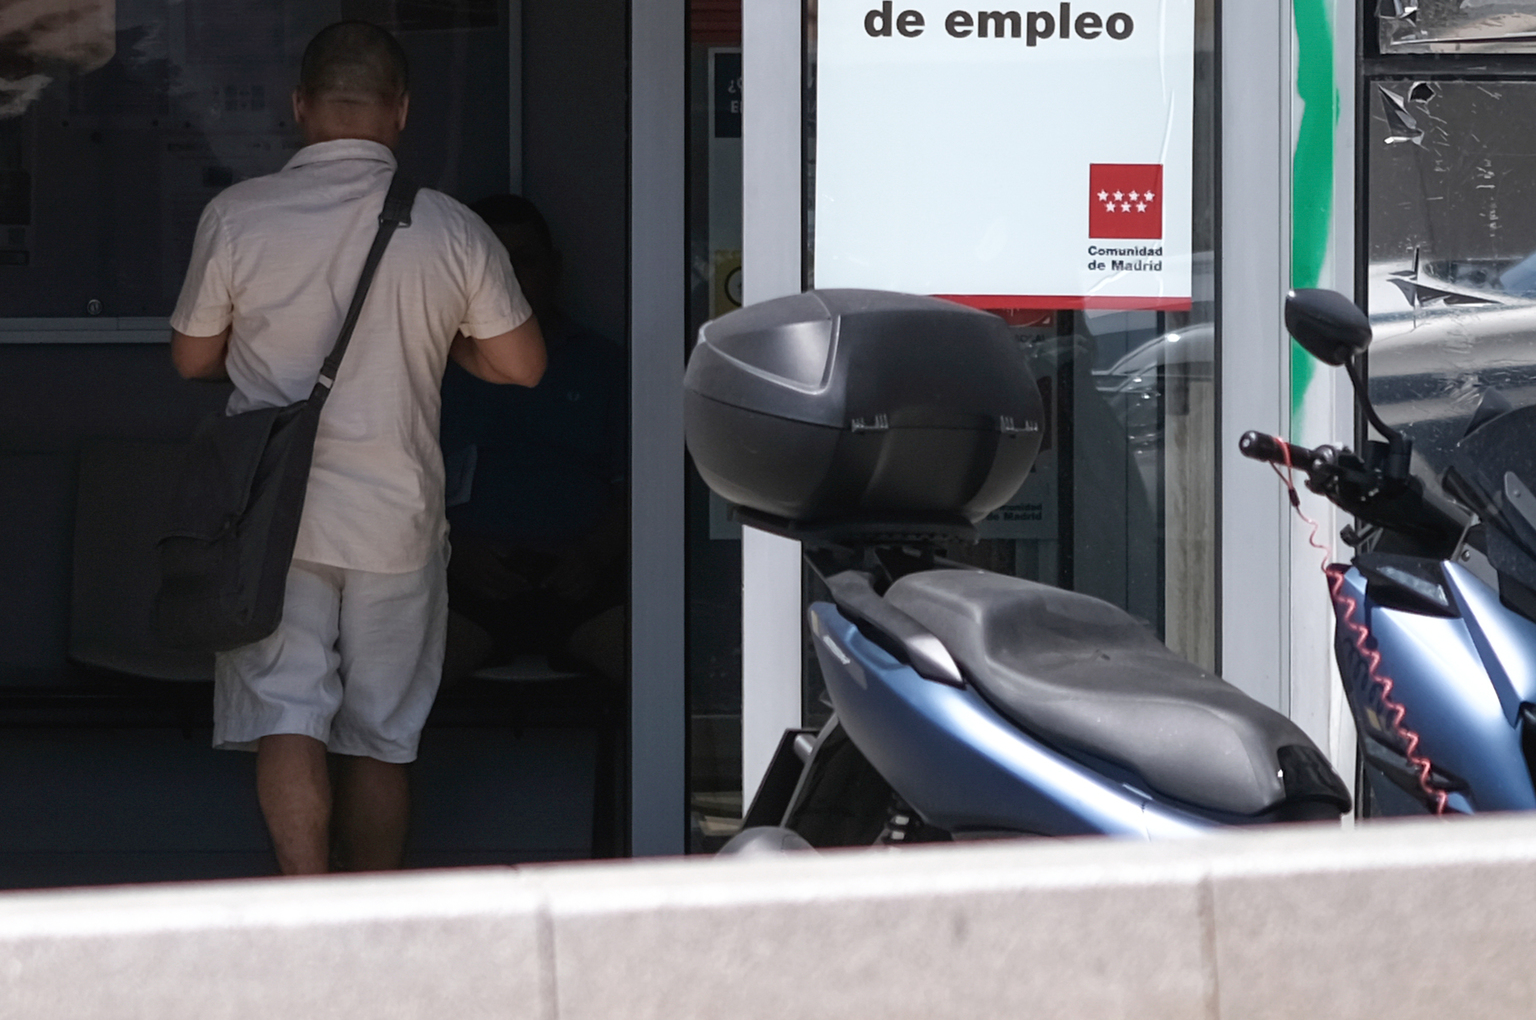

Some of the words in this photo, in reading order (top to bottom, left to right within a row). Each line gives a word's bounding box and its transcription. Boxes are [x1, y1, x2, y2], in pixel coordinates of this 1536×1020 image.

[864, 0, 925, 37] de
[945, 2, 1134, 47] empleo
[1087, 245, 1163, 257] Comunidad
[1087, 260, 1106, 271] de
[1111, 259, 1162, 271] Madrid
